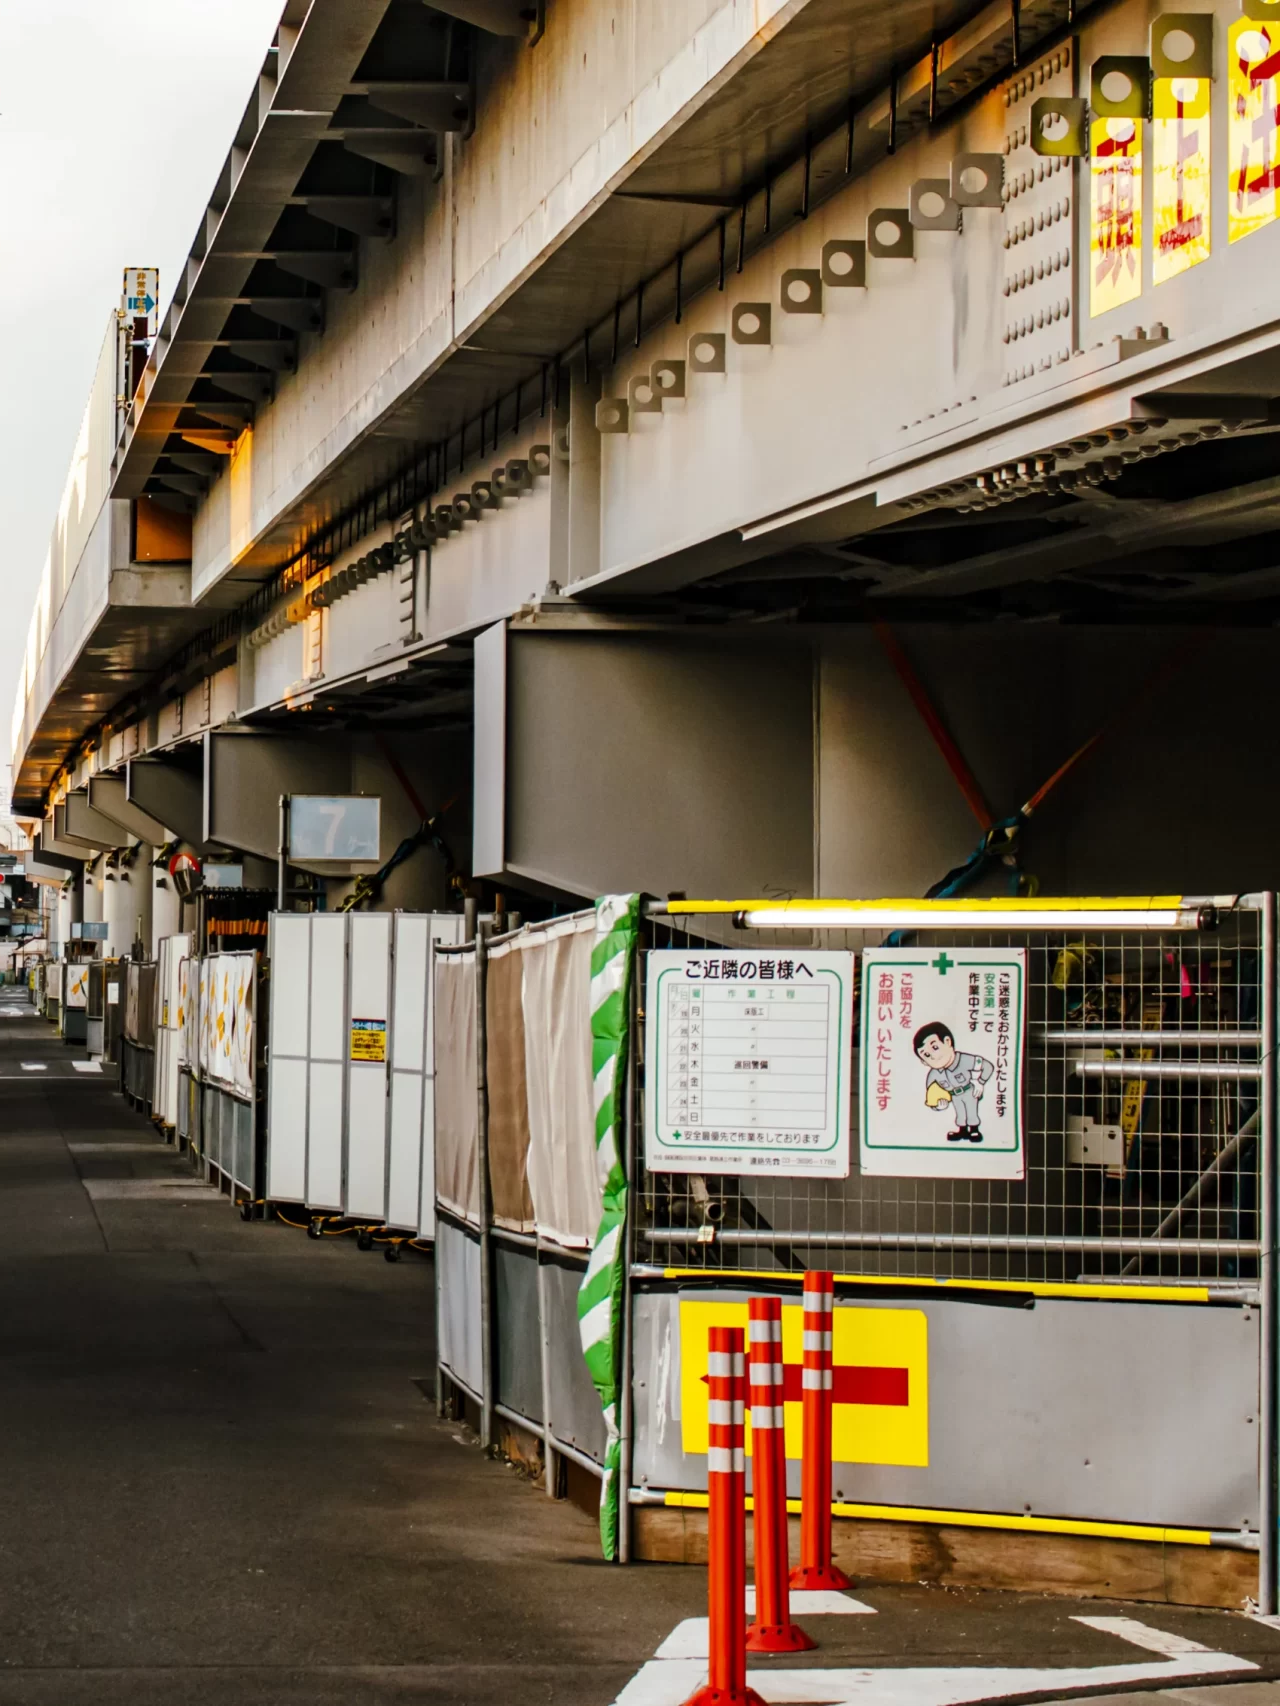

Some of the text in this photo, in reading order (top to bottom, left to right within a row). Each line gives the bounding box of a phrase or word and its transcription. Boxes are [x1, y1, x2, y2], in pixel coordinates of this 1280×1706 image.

[320, 805, 346, 855] 7
[685, 959, 814, 980] ご近隣の皆様へ
[899, 972, 913, 1029] ご協力を
[968, 972, 980, 1032] 作業中です
[983, 972, 996, 1033] 安全第一で
[691, 1006, 701, 1016] 月
[691, 1024, 700, 1034] 火
[690, 1042, 700, 1052] 水
[876, 972, 894, 1112] お願い いたします
[996, 973, 1010, 1118] ご迷惑をおかけいたします
[690, 1060, 700, 1069] 木
[690, 1076, 699, 1087] 金
[690, 1094, 699, 1105] 土
[690, 1112, 699, 1122] 日
[684, 1130, 820, 1144] 安全最優先で作業をしております
